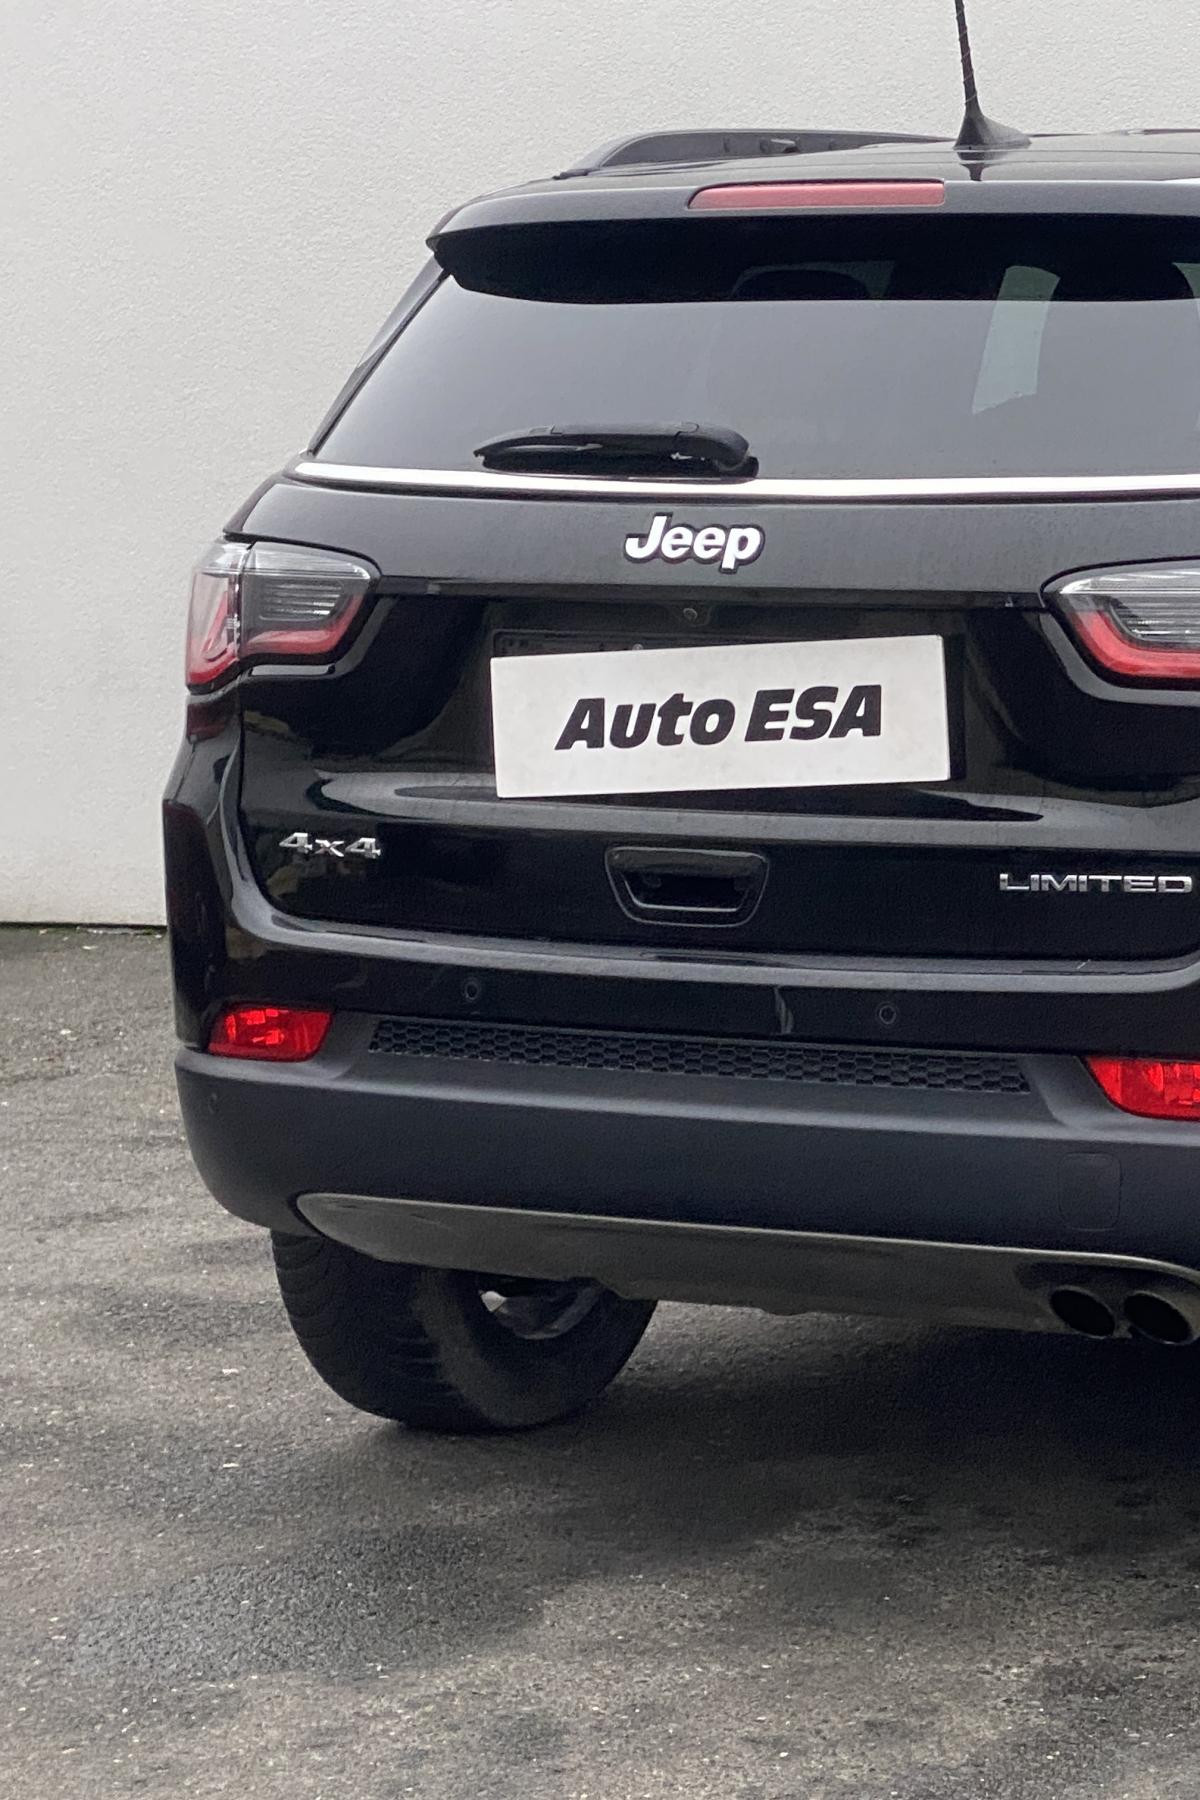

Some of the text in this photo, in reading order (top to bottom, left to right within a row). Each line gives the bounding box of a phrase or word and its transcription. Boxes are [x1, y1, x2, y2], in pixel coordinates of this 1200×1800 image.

[624, 513, 763, 571] Jeep
[554, 684, 882, 751] Auto ESA
[278, 832, 382, 859] 4x4
[999, 873, 1193, 893] LIMITED
